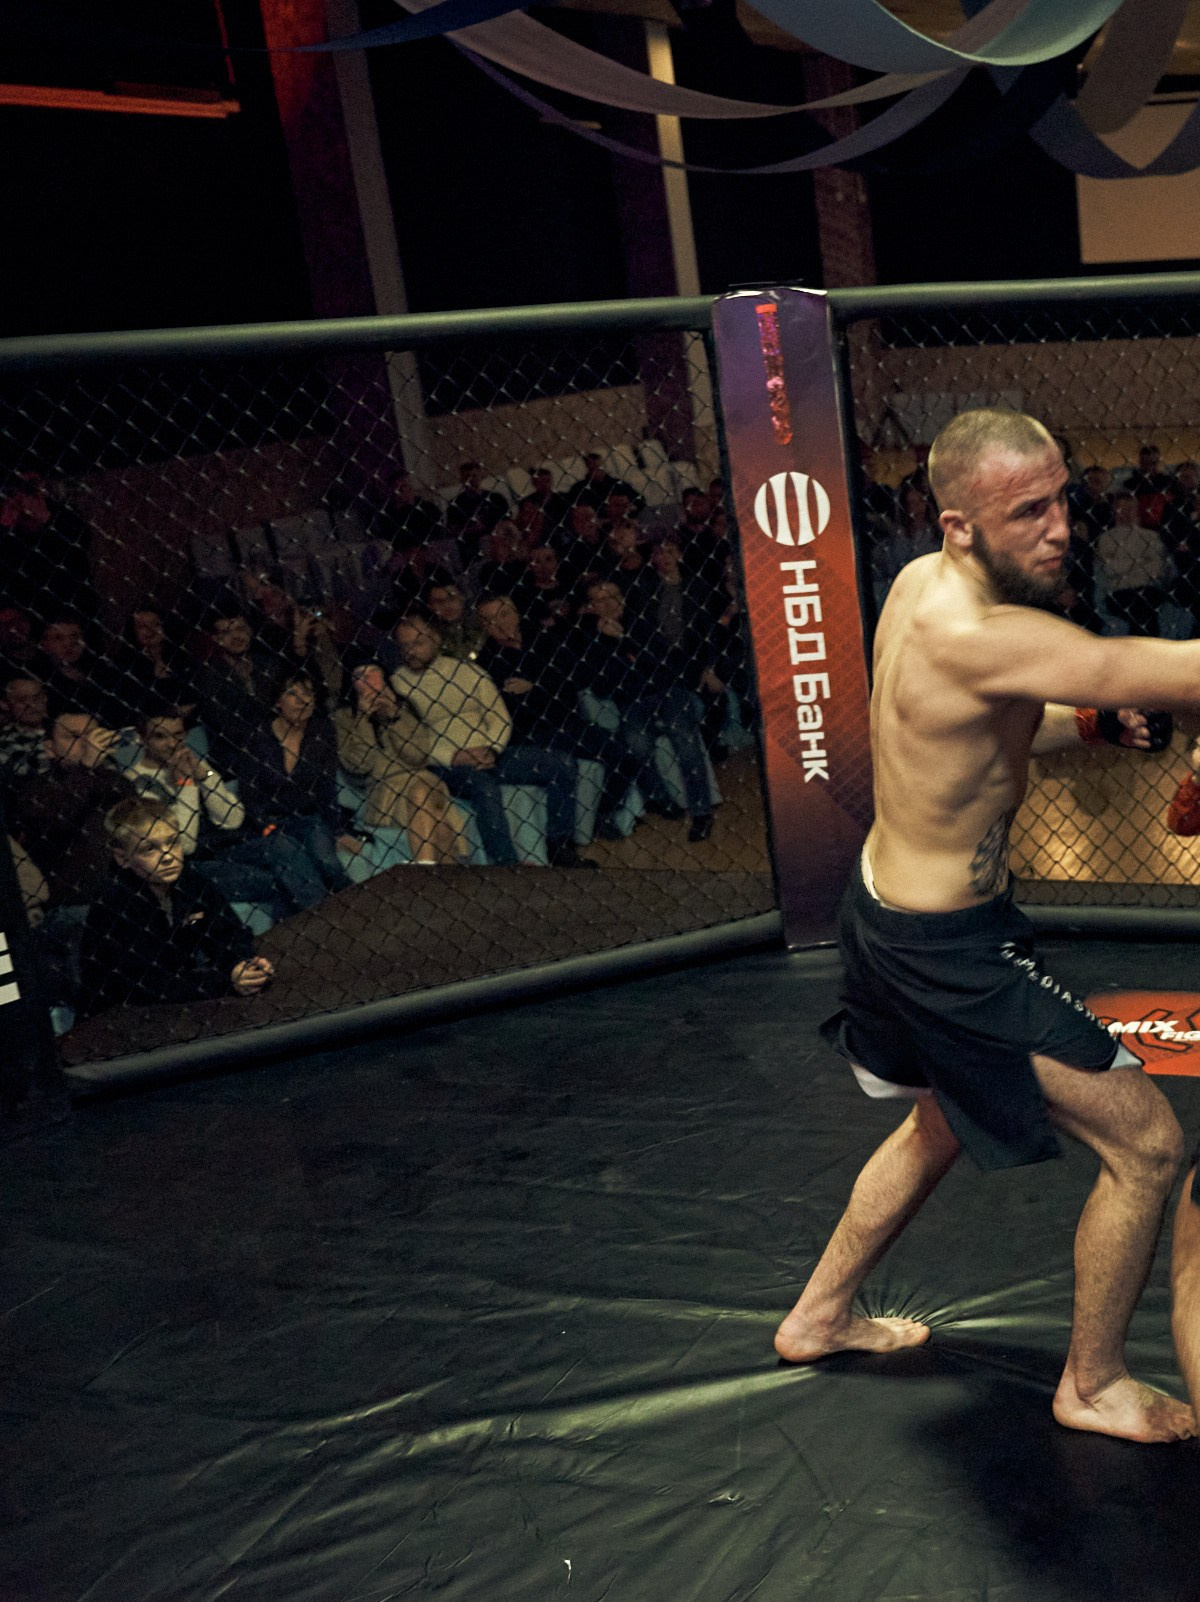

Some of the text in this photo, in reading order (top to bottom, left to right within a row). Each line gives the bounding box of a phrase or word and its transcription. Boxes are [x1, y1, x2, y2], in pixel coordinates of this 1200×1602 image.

[780, 559, 831, 783] НБД Банк
[1107, 1020, 1180, 1036] MIX
